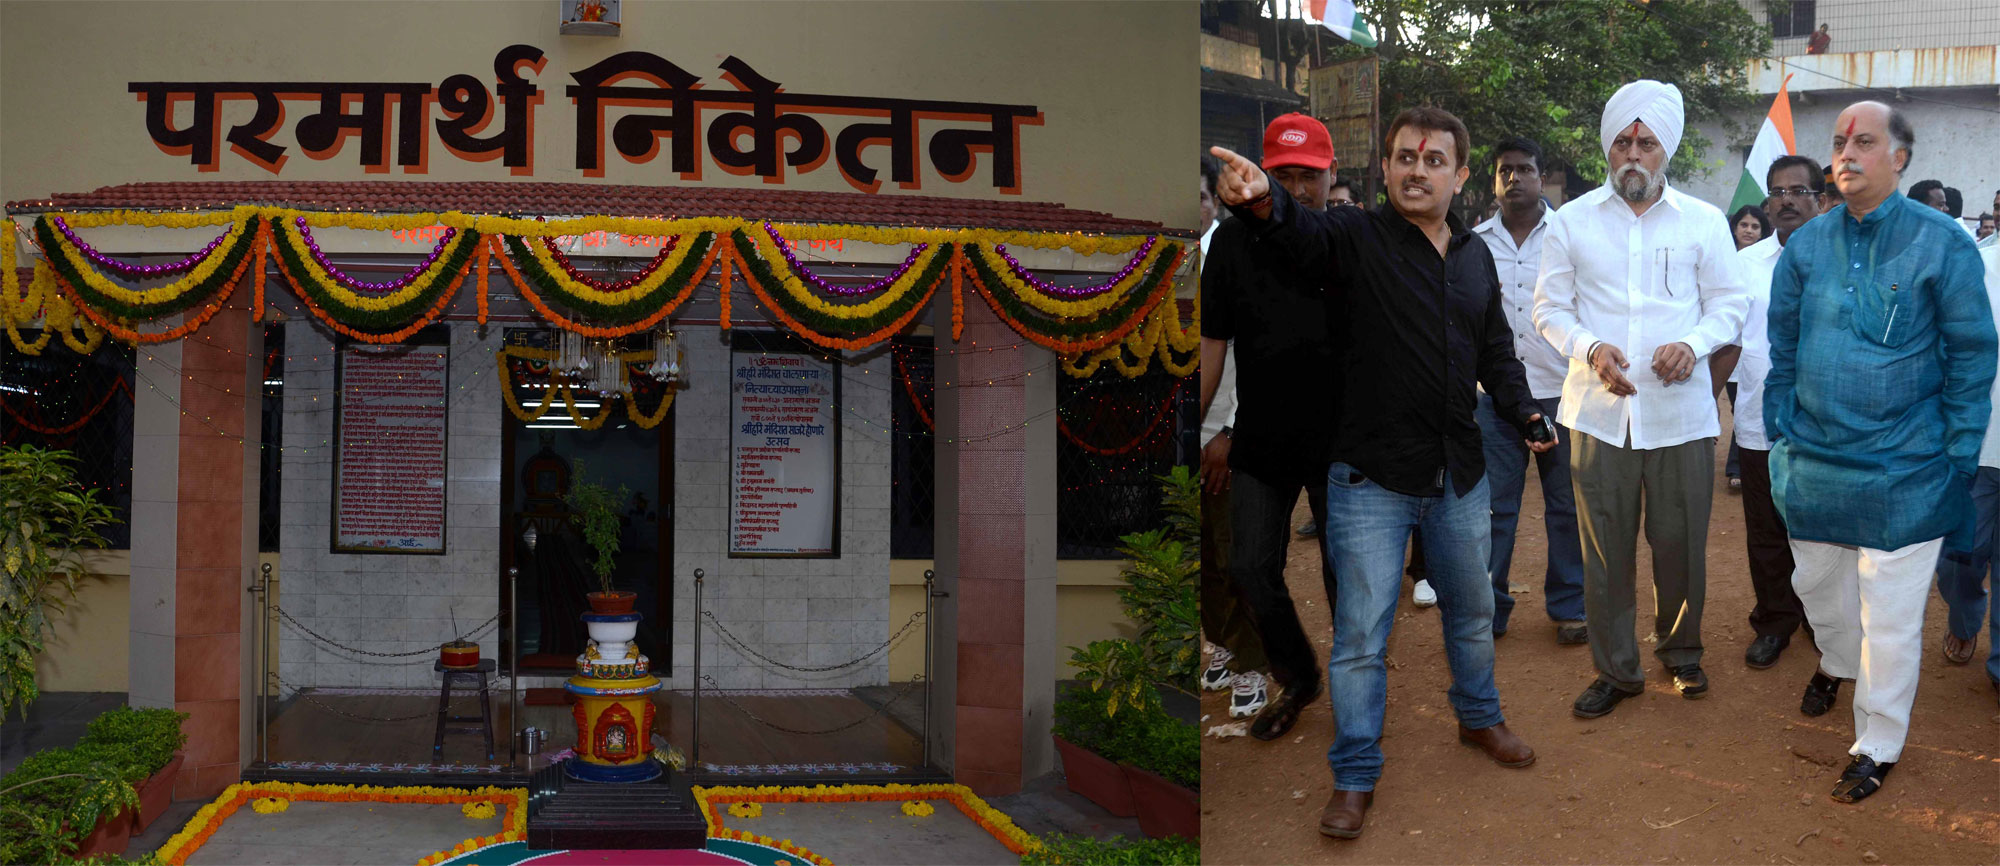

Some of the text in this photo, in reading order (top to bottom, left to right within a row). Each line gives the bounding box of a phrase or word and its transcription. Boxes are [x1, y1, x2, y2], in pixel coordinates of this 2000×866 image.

[128, 44, 1045, 195] परमार्थ निकेतन
[1282, 132, 1304, 144] KDD
[765, 436, 791, 447] उत्सव
